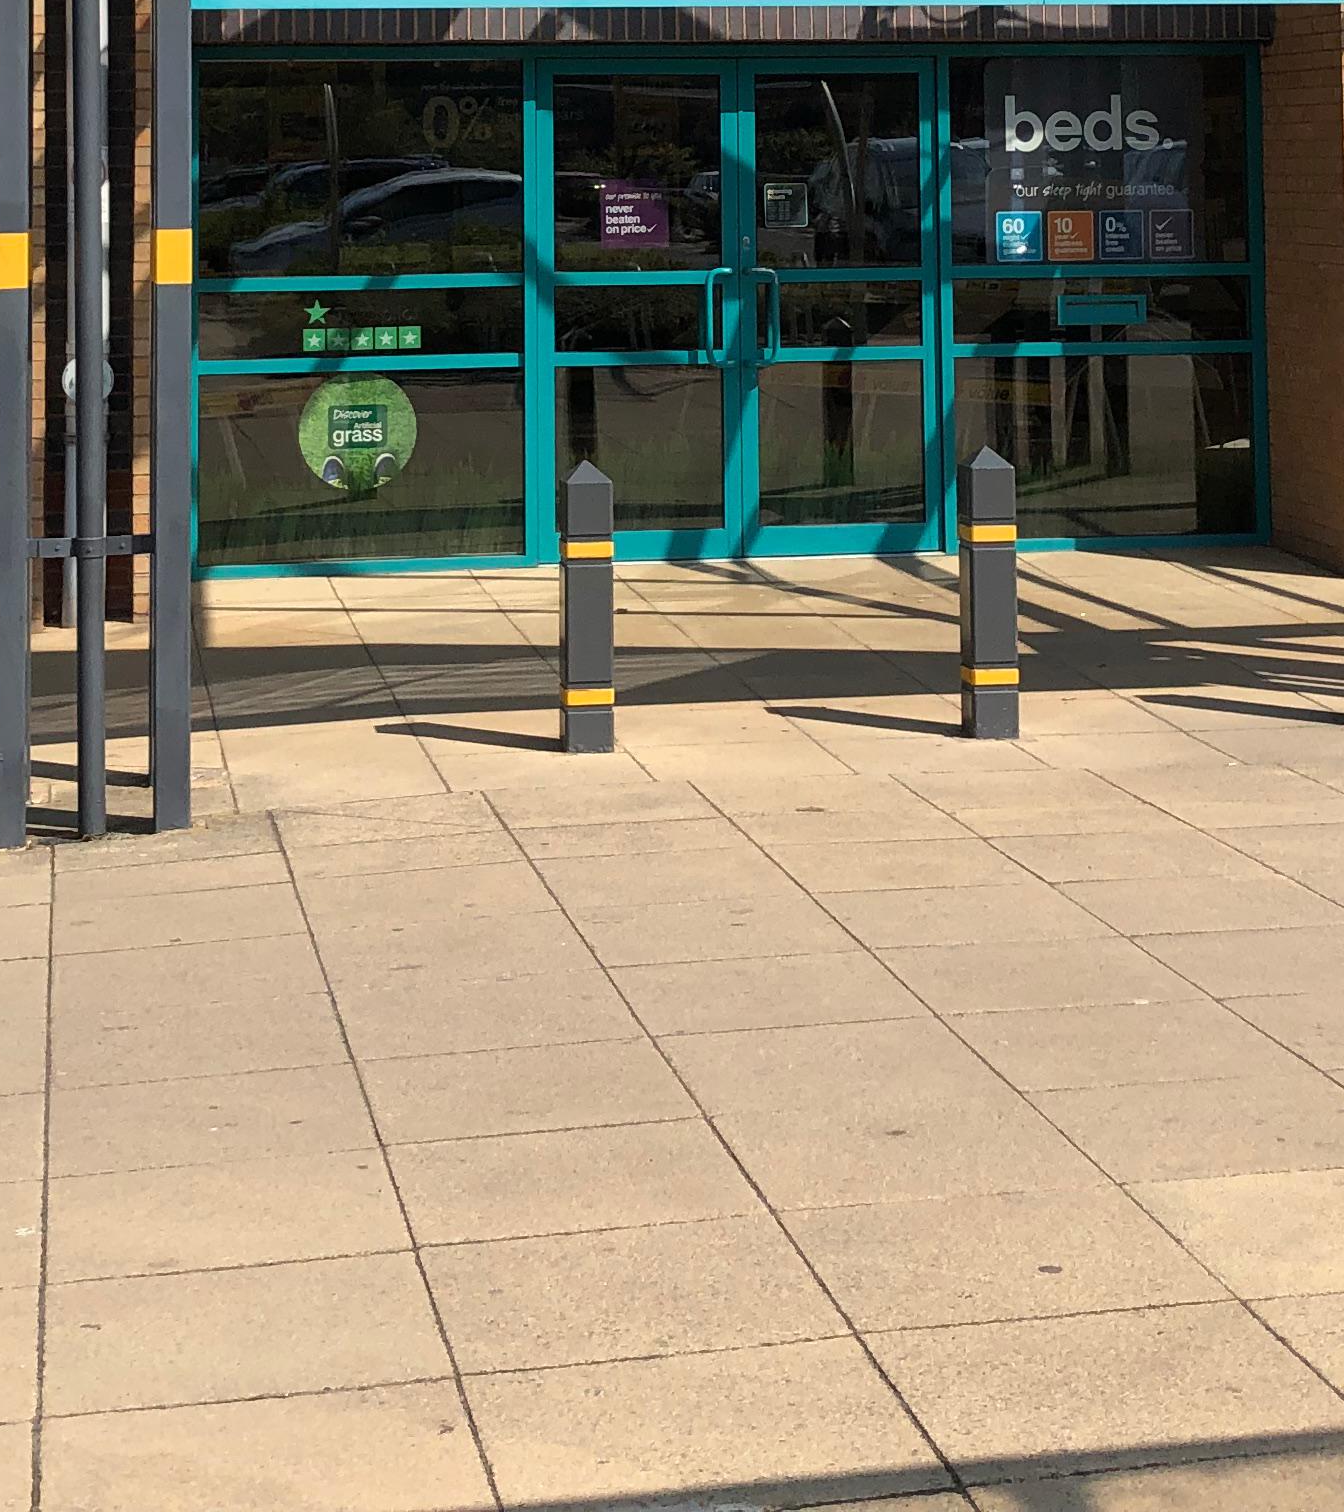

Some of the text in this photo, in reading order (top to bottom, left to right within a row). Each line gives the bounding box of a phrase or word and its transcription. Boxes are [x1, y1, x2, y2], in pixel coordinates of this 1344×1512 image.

[1043, 183, 1072, 200] sleep
[1075, 181, 1102, 201] tight
[1106, 184, 1174, 199] guarantee
[606, 205, 634, 214] never
[606, 215, 640, 224] beaten
[1003, 218, 1024, 234] 60
[1054, 218, 1072, 233] 10
[1105, 217, 1126, 232] 0%
[606, 224, 646, 236] on price
[333, 409, 372, 420] Discover
[333, 429, 382, 447] grass
